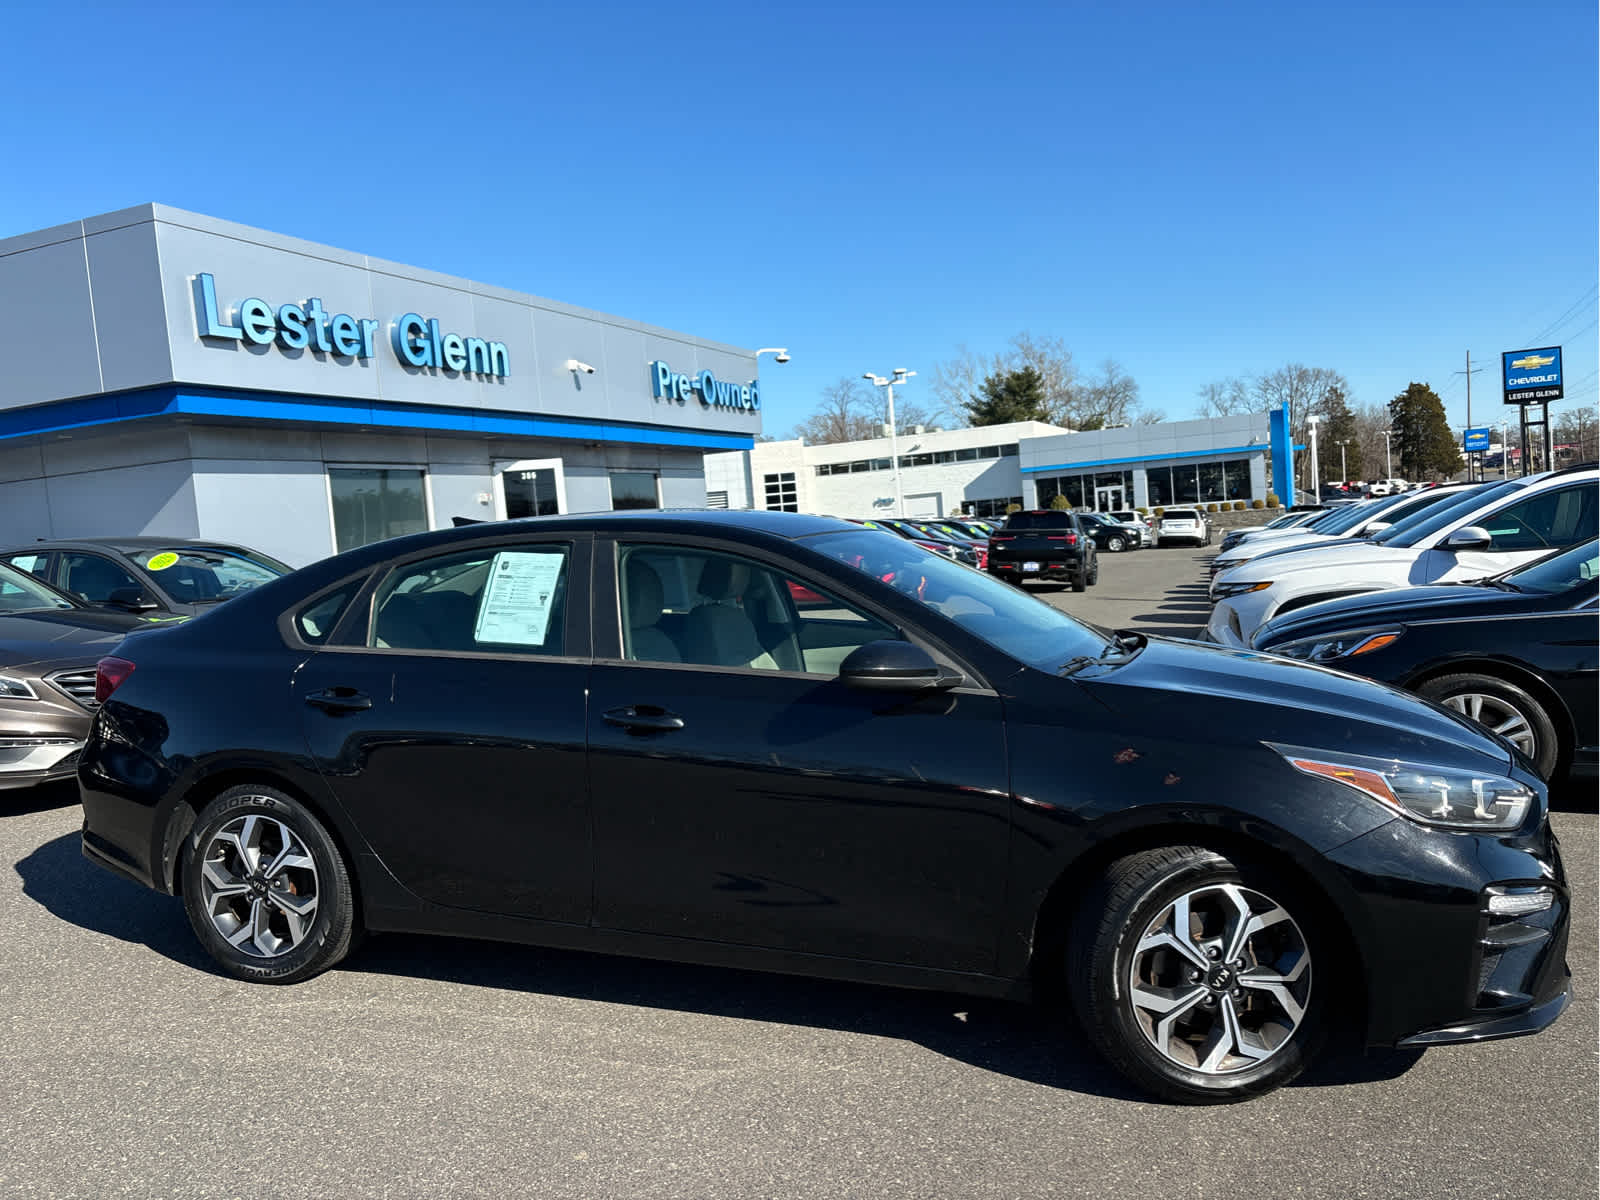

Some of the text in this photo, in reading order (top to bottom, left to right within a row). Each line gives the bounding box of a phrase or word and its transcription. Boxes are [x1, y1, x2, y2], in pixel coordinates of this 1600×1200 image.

[191, 272, 510, 378] Lester Glenn
[651, 360, 761, 411] Pre-Owned
[1508, 374, 1558, 386] CHEVROLET
[1508, 389, 1560, 400] LESTER GLENN
[1211, 968, 1230, 988] KIA
